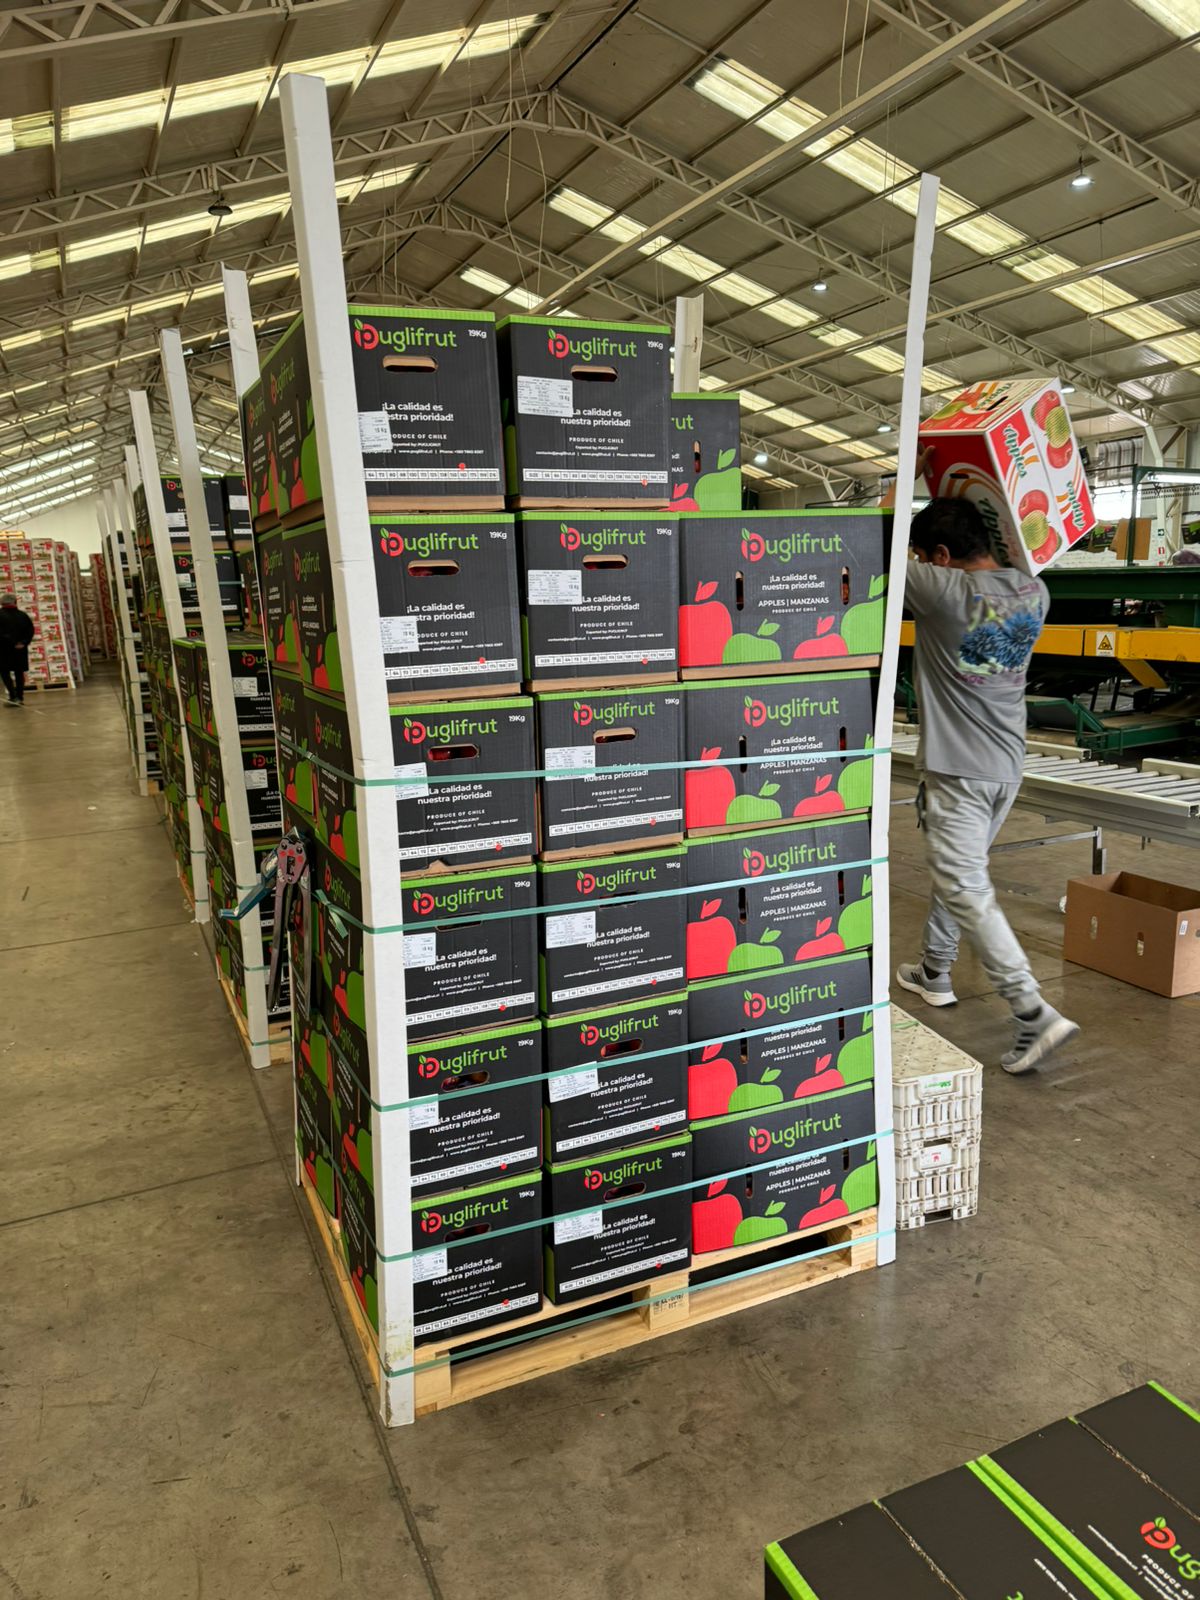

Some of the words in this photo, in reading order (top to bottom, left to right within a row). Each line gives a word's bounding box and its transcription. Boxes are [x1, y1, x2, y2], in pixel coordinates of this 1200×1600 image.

[467, 328, 487, 338] 19Kg
[646, 340, 664, 350] 19Kg
[397, 401, 432, 411] calidad
[582, 407, 612, 417] calidad
[386, 412, 409, 421] estra
[410, 412, 454, 423] prioridad!
[560, 417, 592, 426] nuestra
[593, 417, 631, 428] prioridad!
[1002, 423, 1028, 479] Apples
[489, 530, 508, 540] 19Kg
[656, 527, 672, 536] 19Kg
[769, 575, 780, 583] ¡La
[781, 573, 808, 582] calidad
[761, 583, 790, 591] nuestra
[791, 581, 825, 591] prioridad!
[592, 593, 621, 603] calidad
[757, 598, 785, 607] APPLES
[790, 596, 829, 605] MANZANAS
[421, 601, 454, 612] calidad
[571, 604, 602, 613] nuestra
[603, 602, 640, 613] prioridad!
[416, 613, 432, 622] stra
[433, 610, 476, 622] prioridad!
[664, 696, 680, 706] 19Kg
[508, 713, 526, 723] 19Kg
[782, 735, 807, 745] calidad
[763, 745, 790, 754] nuestra
[791, 741, 823, 752] prioridad!
[759, 760, 786, 769] APPLES
[790, 756, 827, 766] MANZANAS
[583, 773, 613, 783] nuestra
[613, 768, 649, 781] prioridad!
[440, 783, 472, 794] calidad
[472, 783, 483, 791] es
[417, 794, 451, 806] nuestra
[452, 789, 493, 803] prioridad!
[665, 860, 680, 870] 19Kg
[514, 878, 531, 889] 19Kg
[781, 881, 806, 892] calidad
[763, 892, 790, 902] nuestra
[790, 886, 822, 899] prioridad!
[760, 906, 786, 918] APPLES
[790, 900, 827, 912] MANZANAS
[606, 925, 633, 937] calidad
[586, 937, 615, 949] nuestra
[615, 930, 650, 944] prioridad!
[447, 947, 478, 961] calidad
[424, 960, 457, 973] nuestra
[458, 953, 497, 968] prioridad!
[667, 1006, 682, 1017] 19Kg
[763, 1032, 790, 1043] nuestra
[790, 1024, 822, 1038] prioridad!
[517, 1037, 534, 1048] 19Kg
[760, 1046, 786, 1058] APPLES
[790, 1037, 826, 1051] MANZANAS
[609, 1073, 636, 1086] calidad
[636, 1072, 645, 1080] es
[590, 1085, 618, 1099] nuestra
[619, 1076, 653, 1092] prioridad!
[451, 1107, 481, 1122] calidad
[482, 1107, 492, 1115] es
[429, 1120, 461, 1135] nuestra
[462, 1111, 501, 1128] prioridad!
[671, 1148, 686, 1159] 19Kg
[768, 1165, 795, 1177] nuestra
[795, 1156, 827, 1171] prioridad!
[765, 1179, 791, 1192] APPLES
[795, 1168, 831, 1184] MANZANAS
[519, 1188, 535, 1200] 19Kg
[612, 1214, 639, 1228] calidad
[639, 1213, 648, 1221] es
[593, 1227, 621, 1241] nuestra
[622, 1217, 656, 1234] prioridad!
[454, 1258, 483, 1273] calidad
[484, 1257, 494, 1265] es
[432, 1272, 463, 1287] nuestra
[464, 1261, 502, 1279] prioridad!
